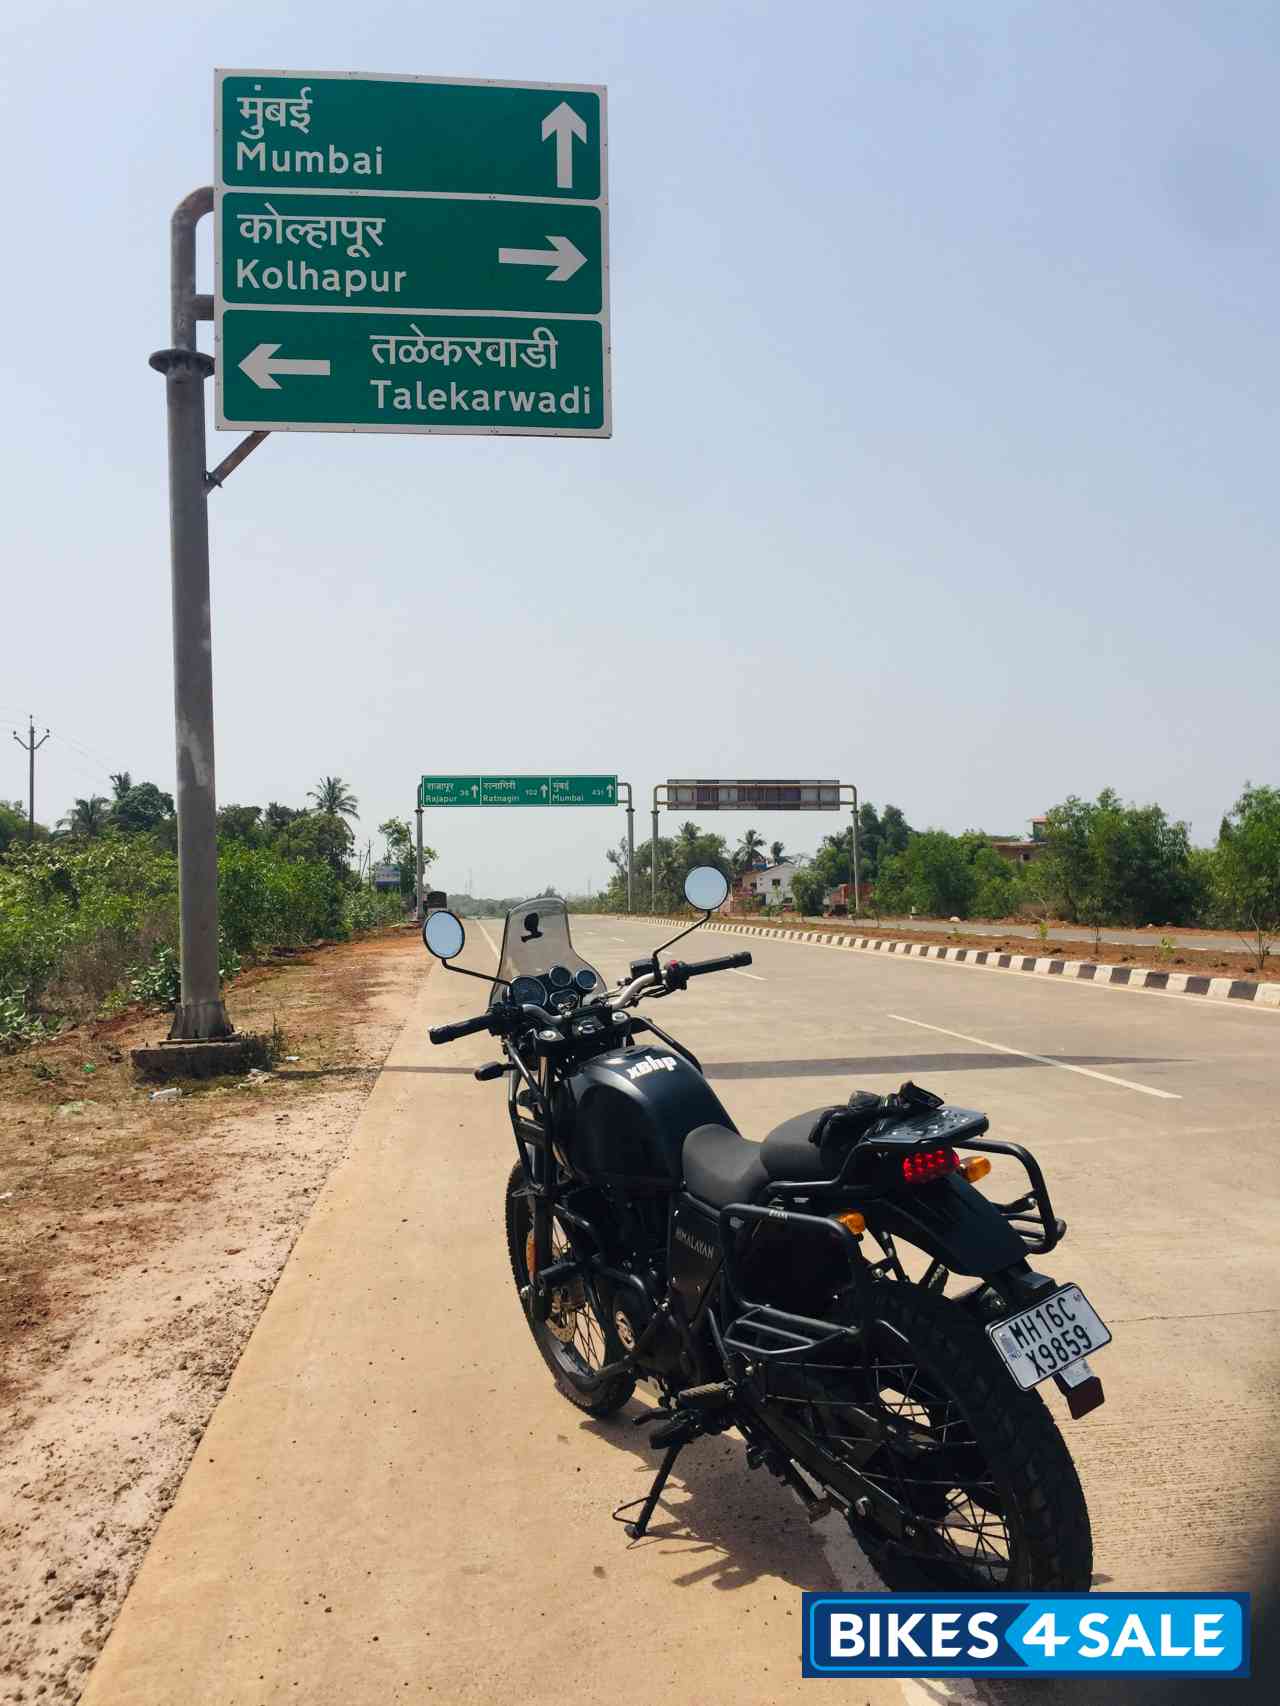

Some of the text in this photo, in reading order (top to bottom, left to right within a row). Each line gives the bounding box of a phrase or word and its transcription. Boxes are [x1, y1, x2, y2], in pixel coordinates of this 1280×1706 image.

[236, 84, 313, 139] मुंबई
[236, 142, 384, 175] Mumbai
[236, 202, 387, 259] कोल्हापूर
[236, 258, 407, 298] Kolhapur
[369, 323, 559, 370] तळेकरवाडी
[369, 379, 592, 415] Talekarwadi
[552, 792, 584, 801] Mumbai
[1008, 1297, 1077, 1350] MH16C
[1025, 1324, 1093, 1379] X9859
